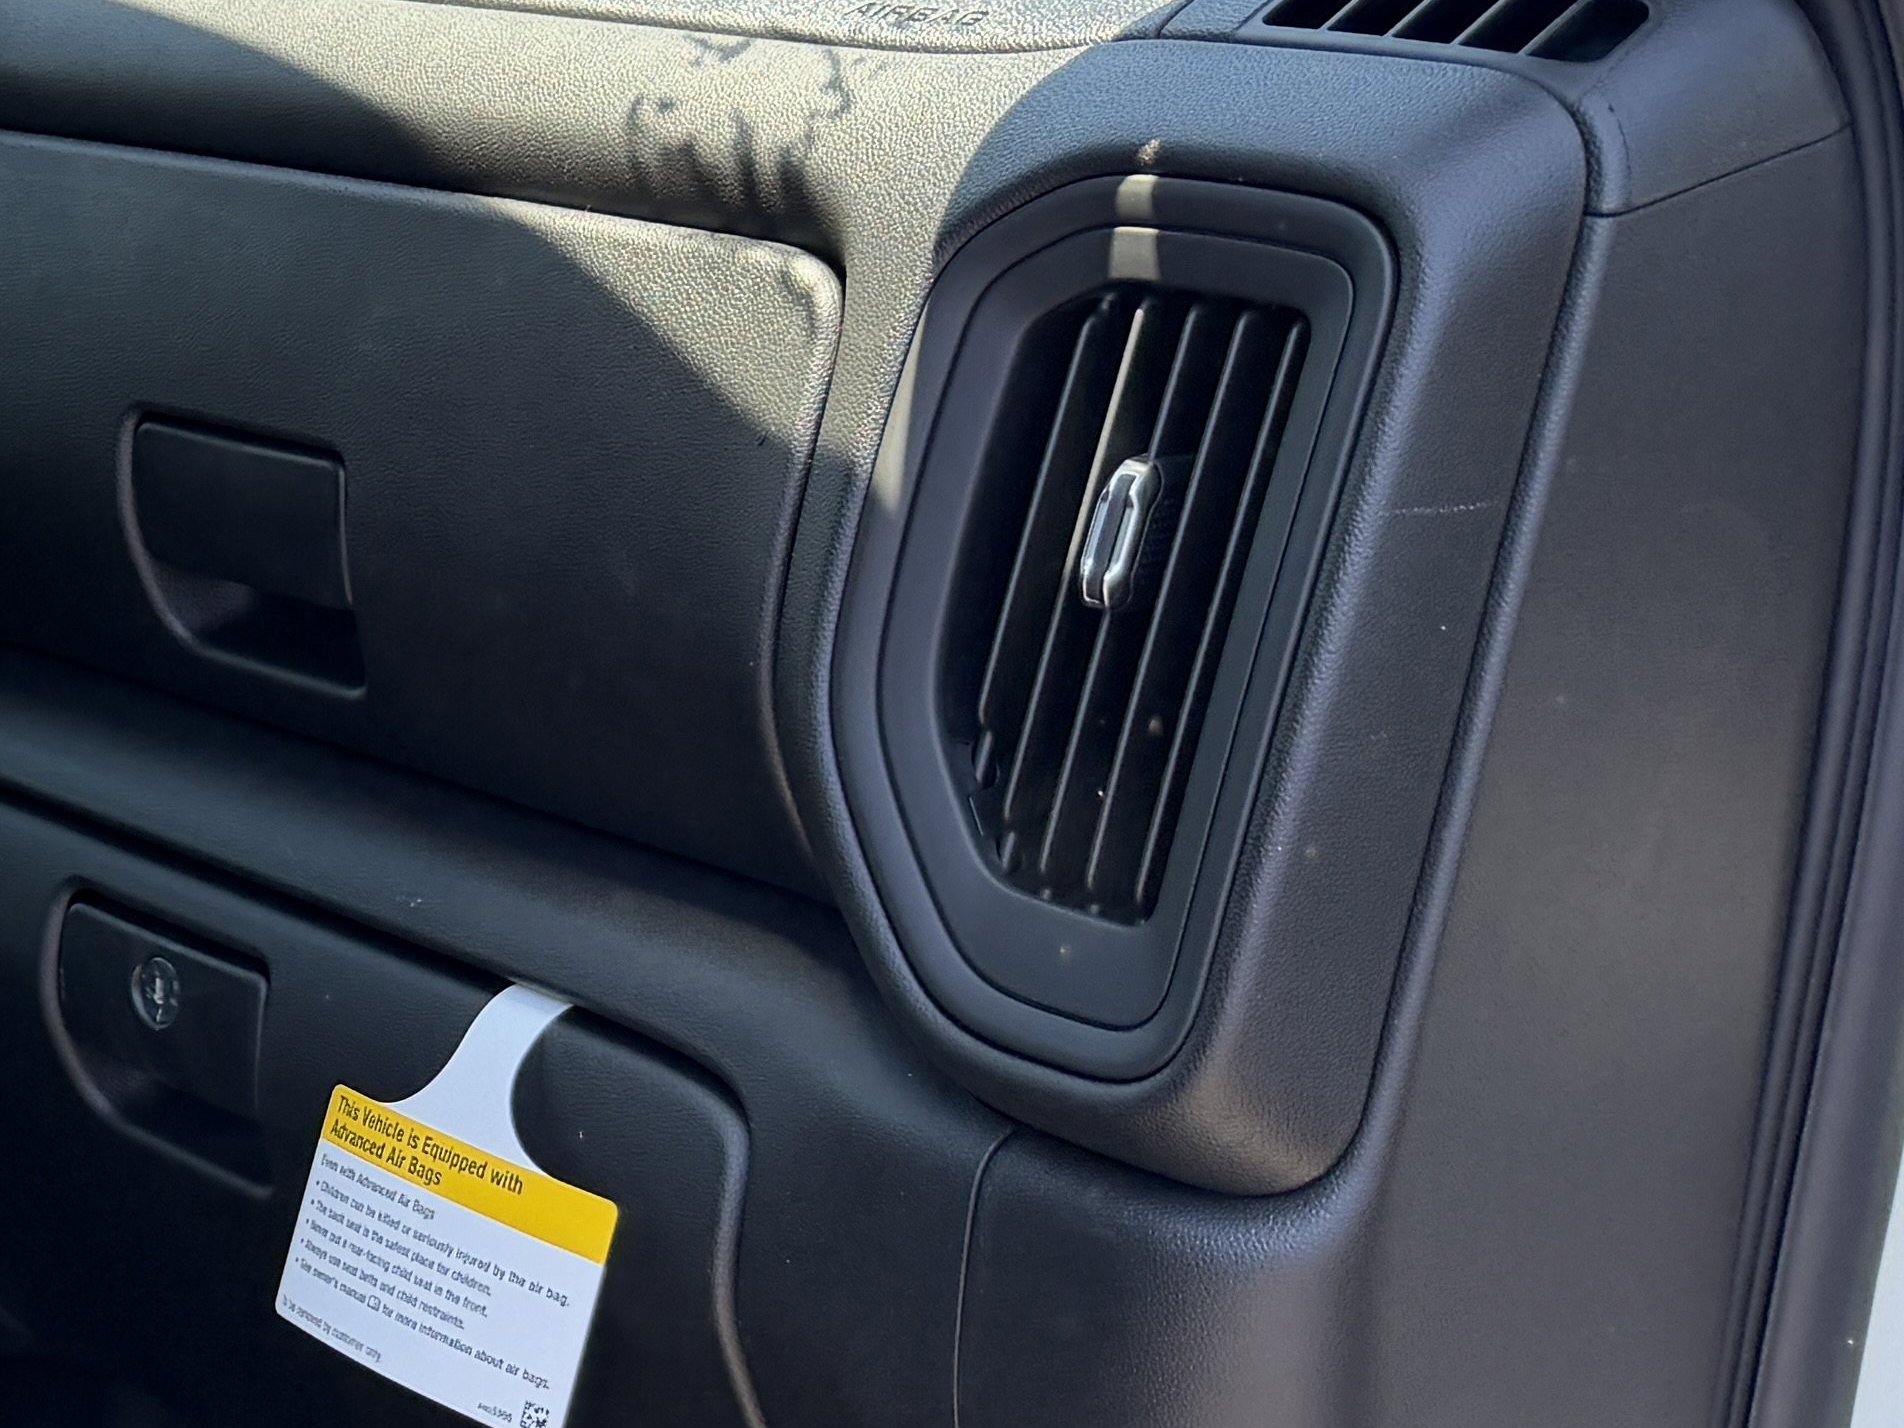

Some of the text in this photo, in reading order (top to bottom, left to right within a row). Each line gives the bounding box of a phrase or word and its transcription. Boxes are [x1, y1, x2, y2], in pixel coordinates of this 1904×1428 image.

[842, 0, 990, 26] AIRBAG
[330, 1119, 442, 1186] Advanced Air Bags
[338, 1095, 523, 1195] This Vehicle is Equipped with
[321, 1153, 435, 1220] Even with Advanced Air Bags
[315, 1199, 491, 1297] The back seat is the safest place for children.
[320, 1180, 569, 1307] Children can be killed or seriously injured by the air bag.
[349, 1243, 391, 1273] rear-facing
[391, 1265, 414, 1282] child
[413, 1275, 433, 1292] seat
[433, 1285, 443, 1297] in
[444, 1289, 461, 1305] the
[462, 1296, 488, 1318] front.
[342, 1261, 359, 1277] seat
[358, 1270, 378, 1288] belts
[379, 1282, 396, 1296] and
[396, 1290, 418, 1308] child
[395, 1312, 418, 1330] more
[419, 1323, 473, 1356] information
[474, 1350, 504, 1370] about
[505, 1363, 520, 1376] air
[522, 1368, 550, 1390] bags.
